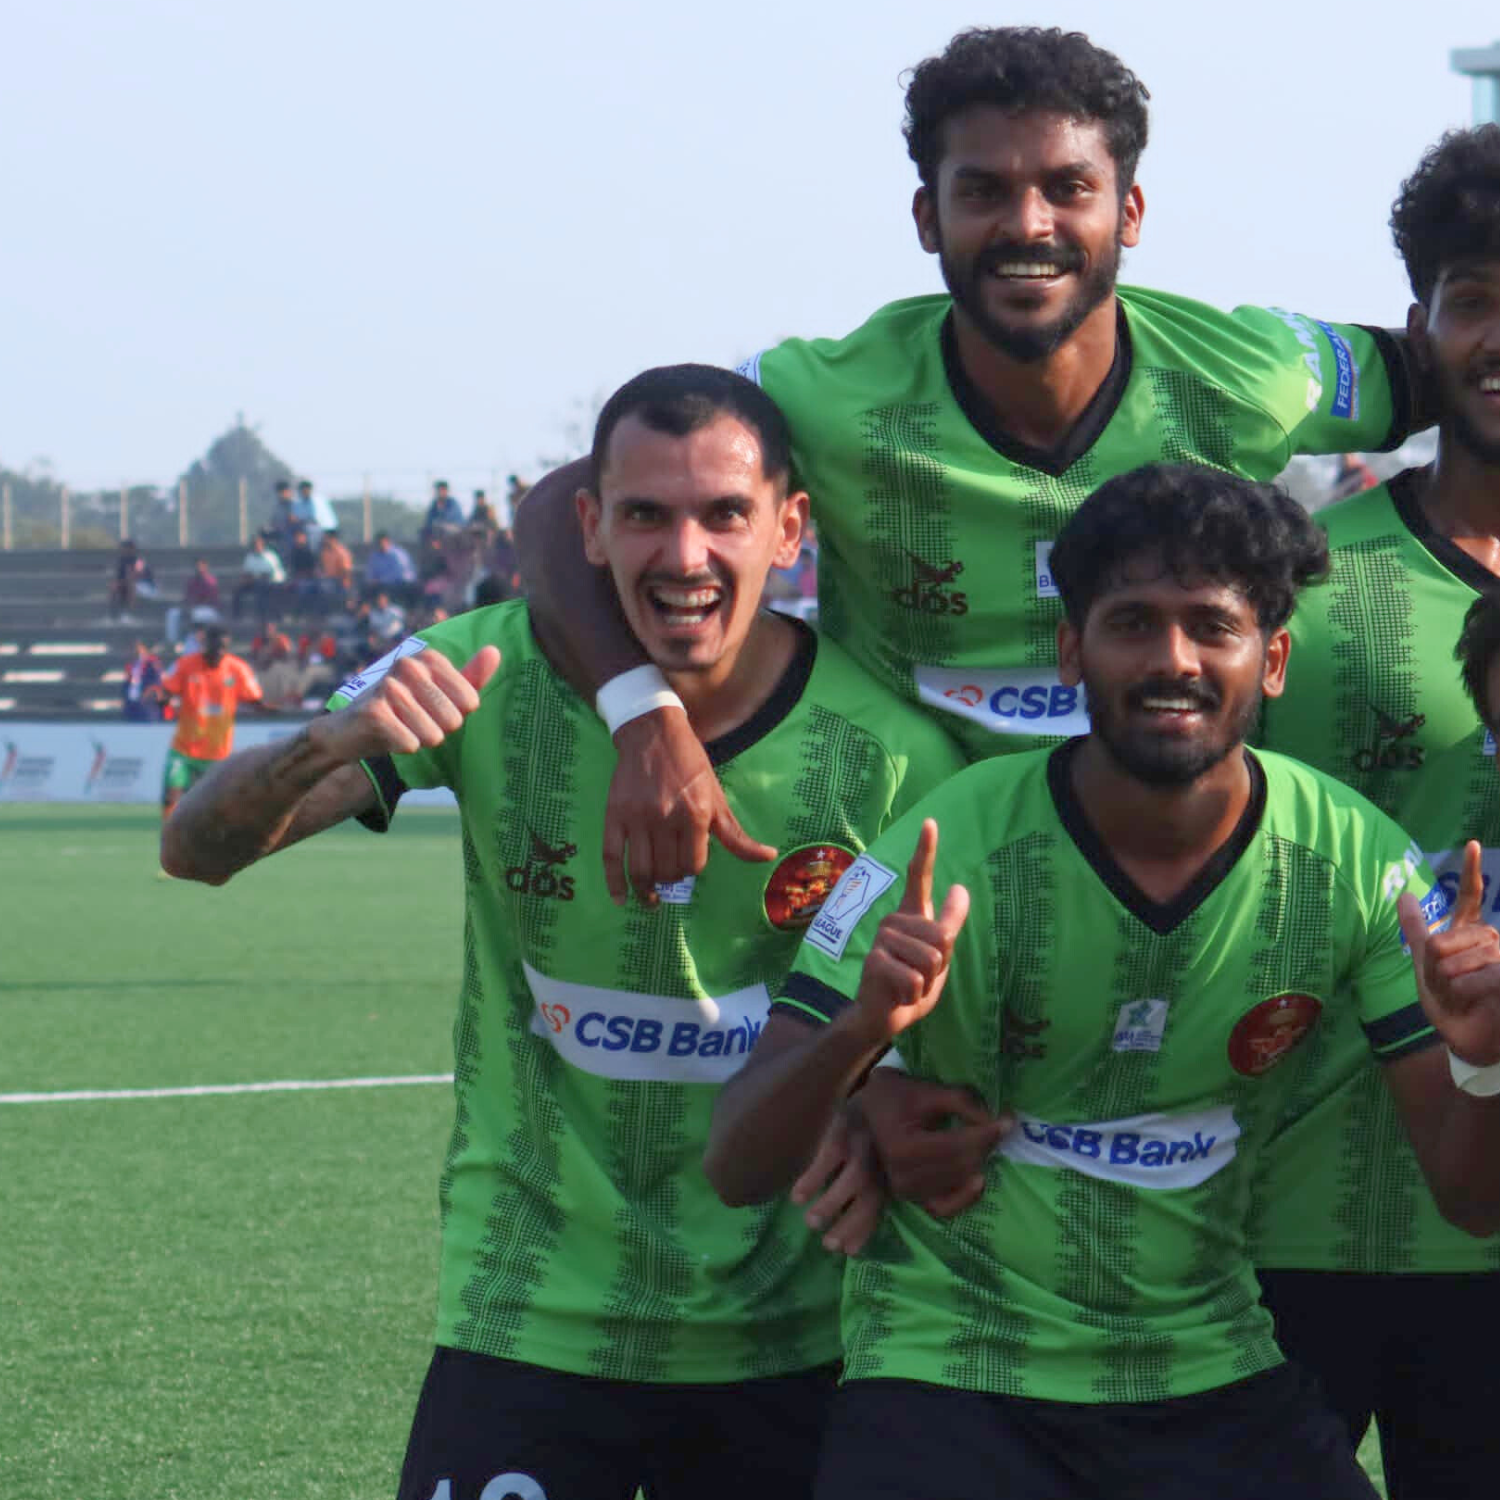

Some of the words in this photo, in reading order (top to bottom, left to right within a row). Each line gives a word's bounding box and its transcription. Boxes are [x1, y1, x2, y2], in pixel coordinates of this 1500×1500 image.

[989, 685, 1078, 719] CSB
[574, 1012, 664, 1054] CSB
[1109, 1131, 1217, 1167] Bank
